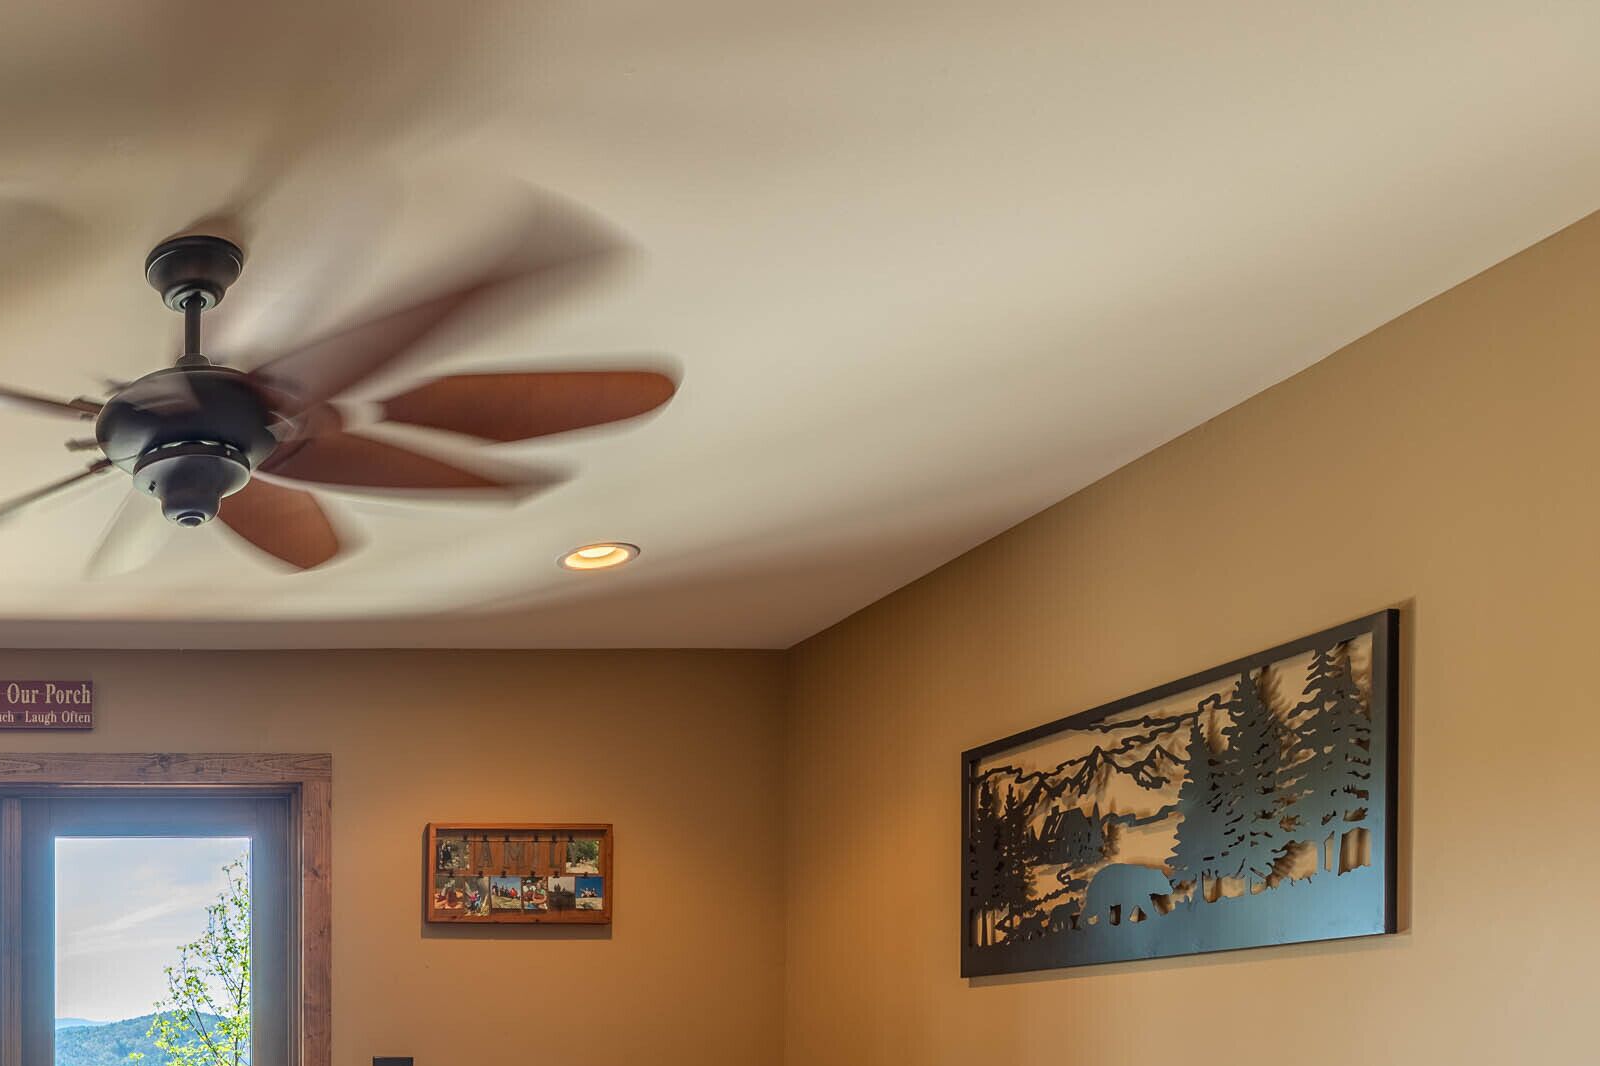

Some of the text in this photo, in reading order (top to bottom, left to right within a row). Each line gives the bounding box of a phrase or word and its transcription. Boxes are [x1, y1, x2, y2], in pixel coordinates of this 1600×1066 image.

[7, 682, 39, 704] Our
[45, 683, 91, 705] Porch
[25, 711, 57, 726] Laugh
[61, 711, 91, 723] Often
